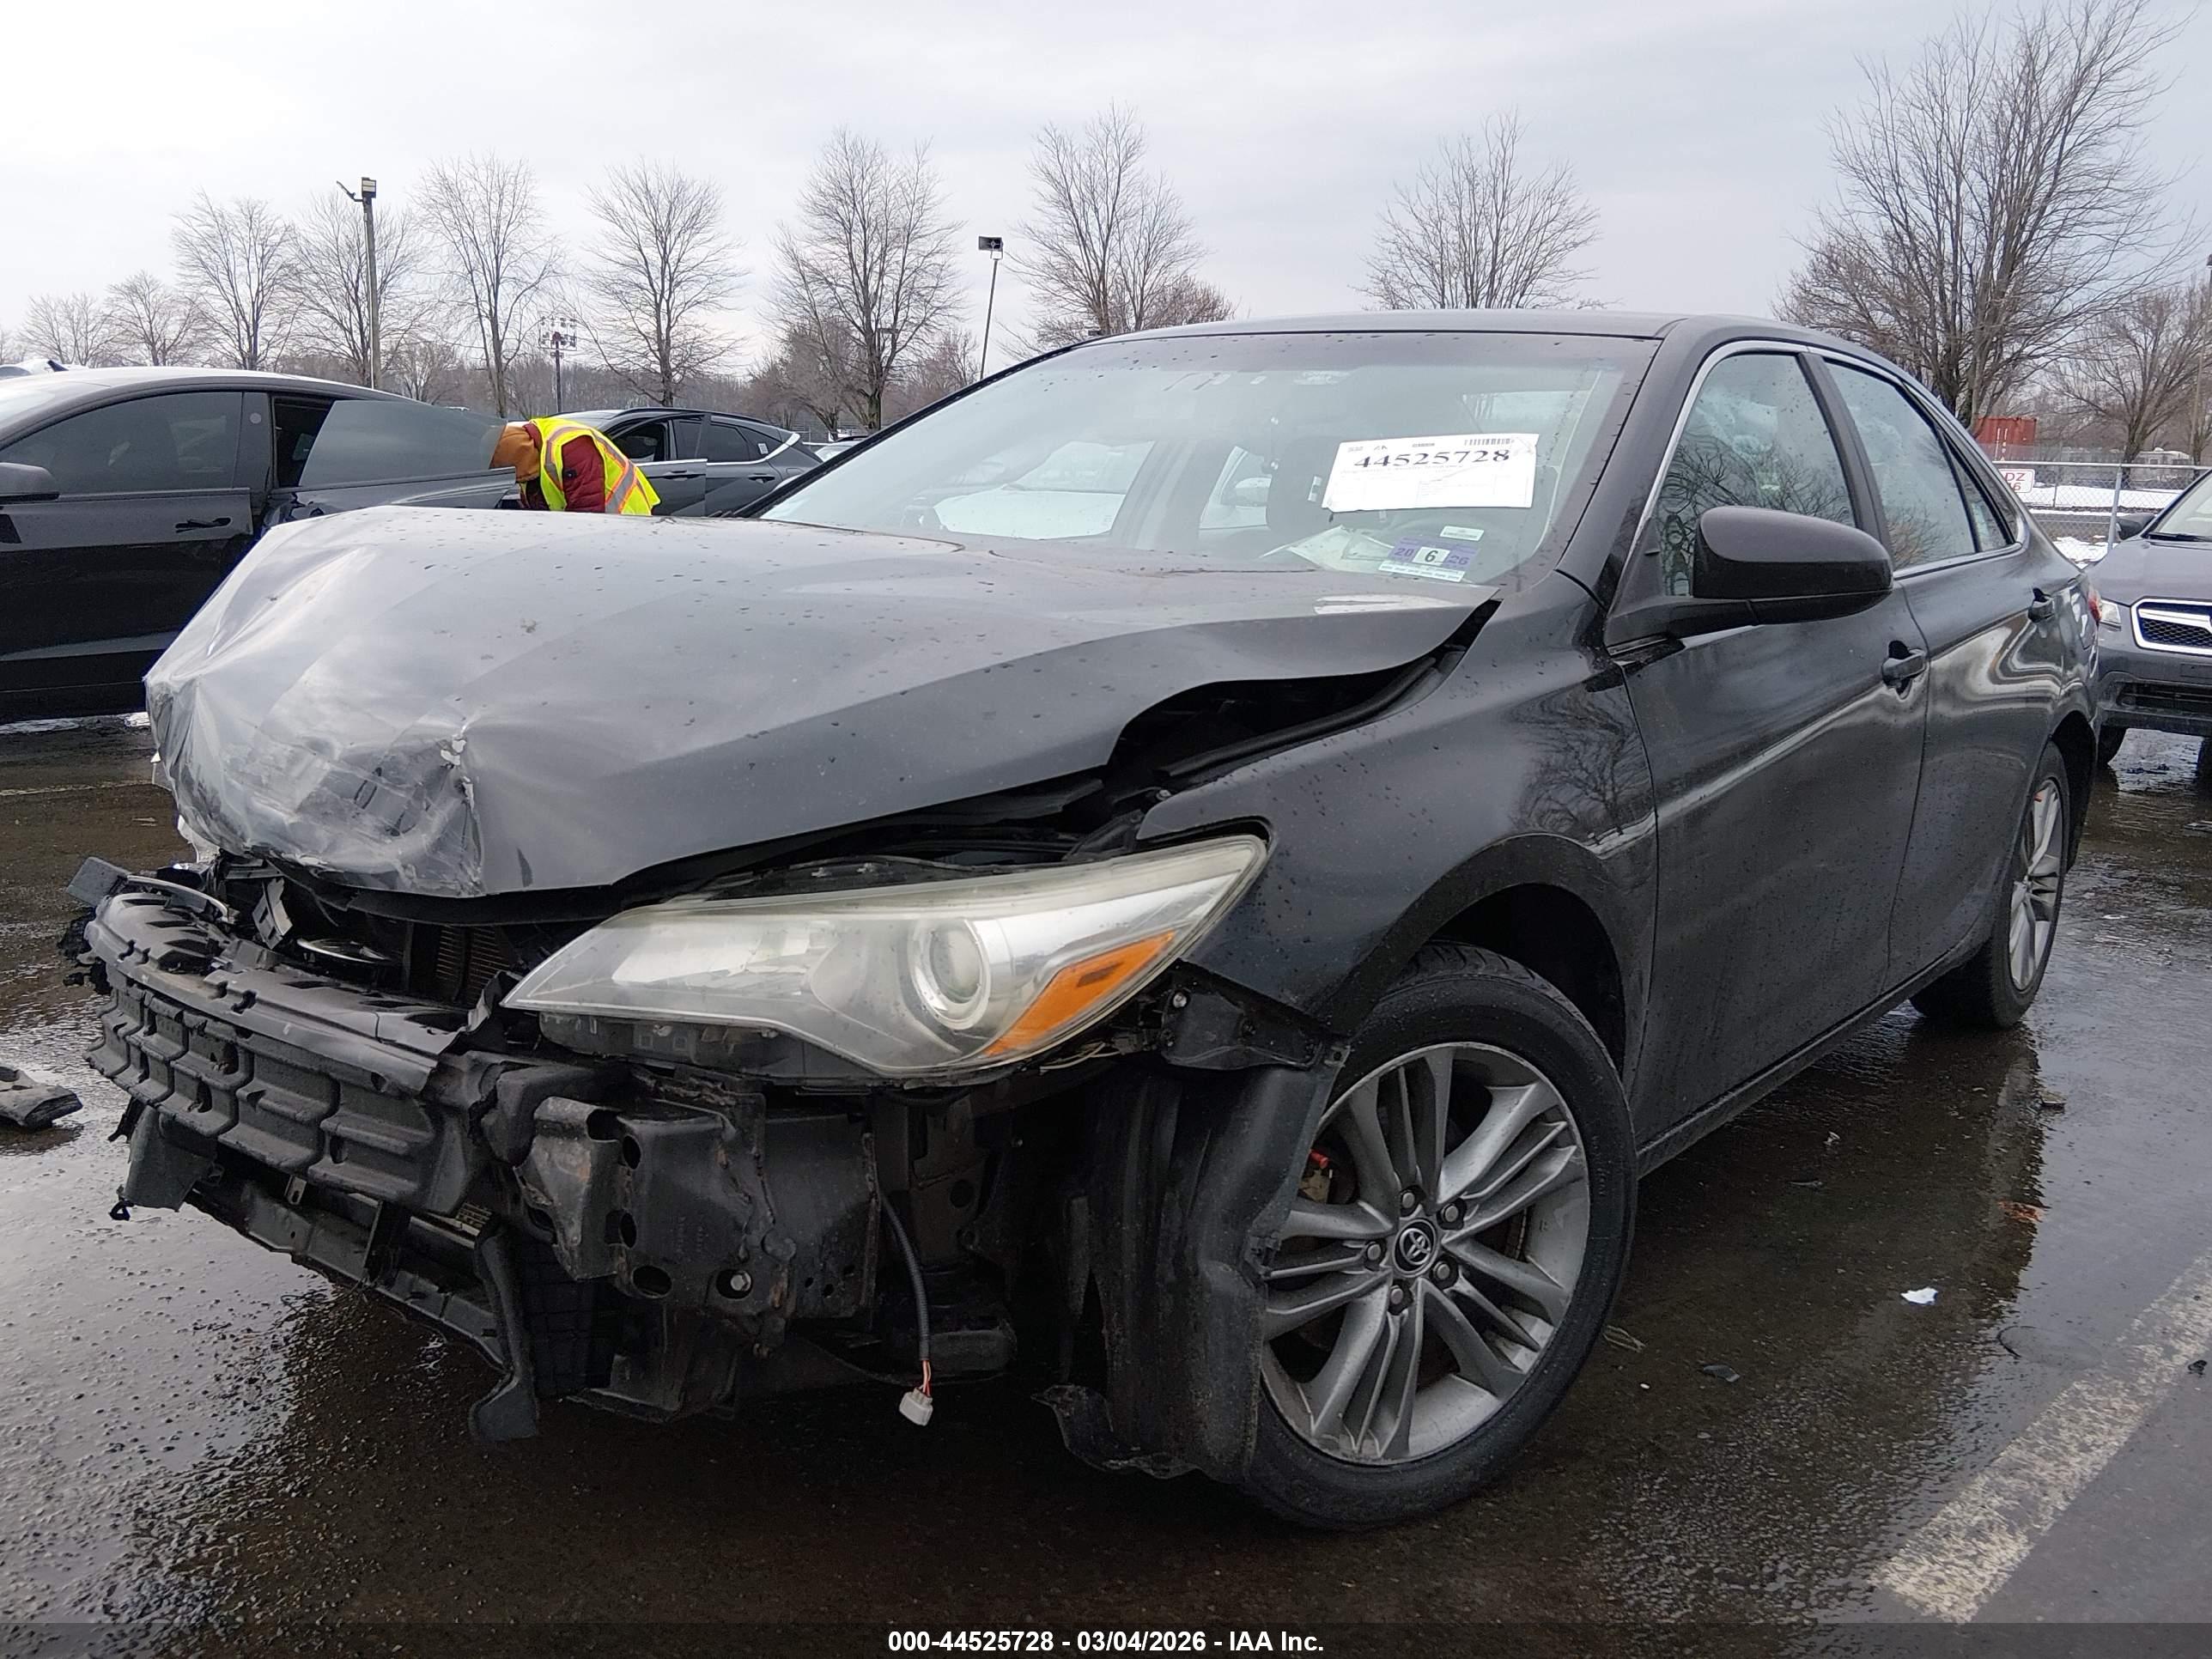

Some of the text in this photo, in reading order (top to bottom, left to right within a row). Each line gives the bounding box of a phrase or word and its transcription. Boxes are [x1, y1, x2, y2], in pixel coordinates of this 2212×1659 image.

[1353, 449, 1510, 468] 44525728
[1394, 548, 1470, 565] 20 6 26
